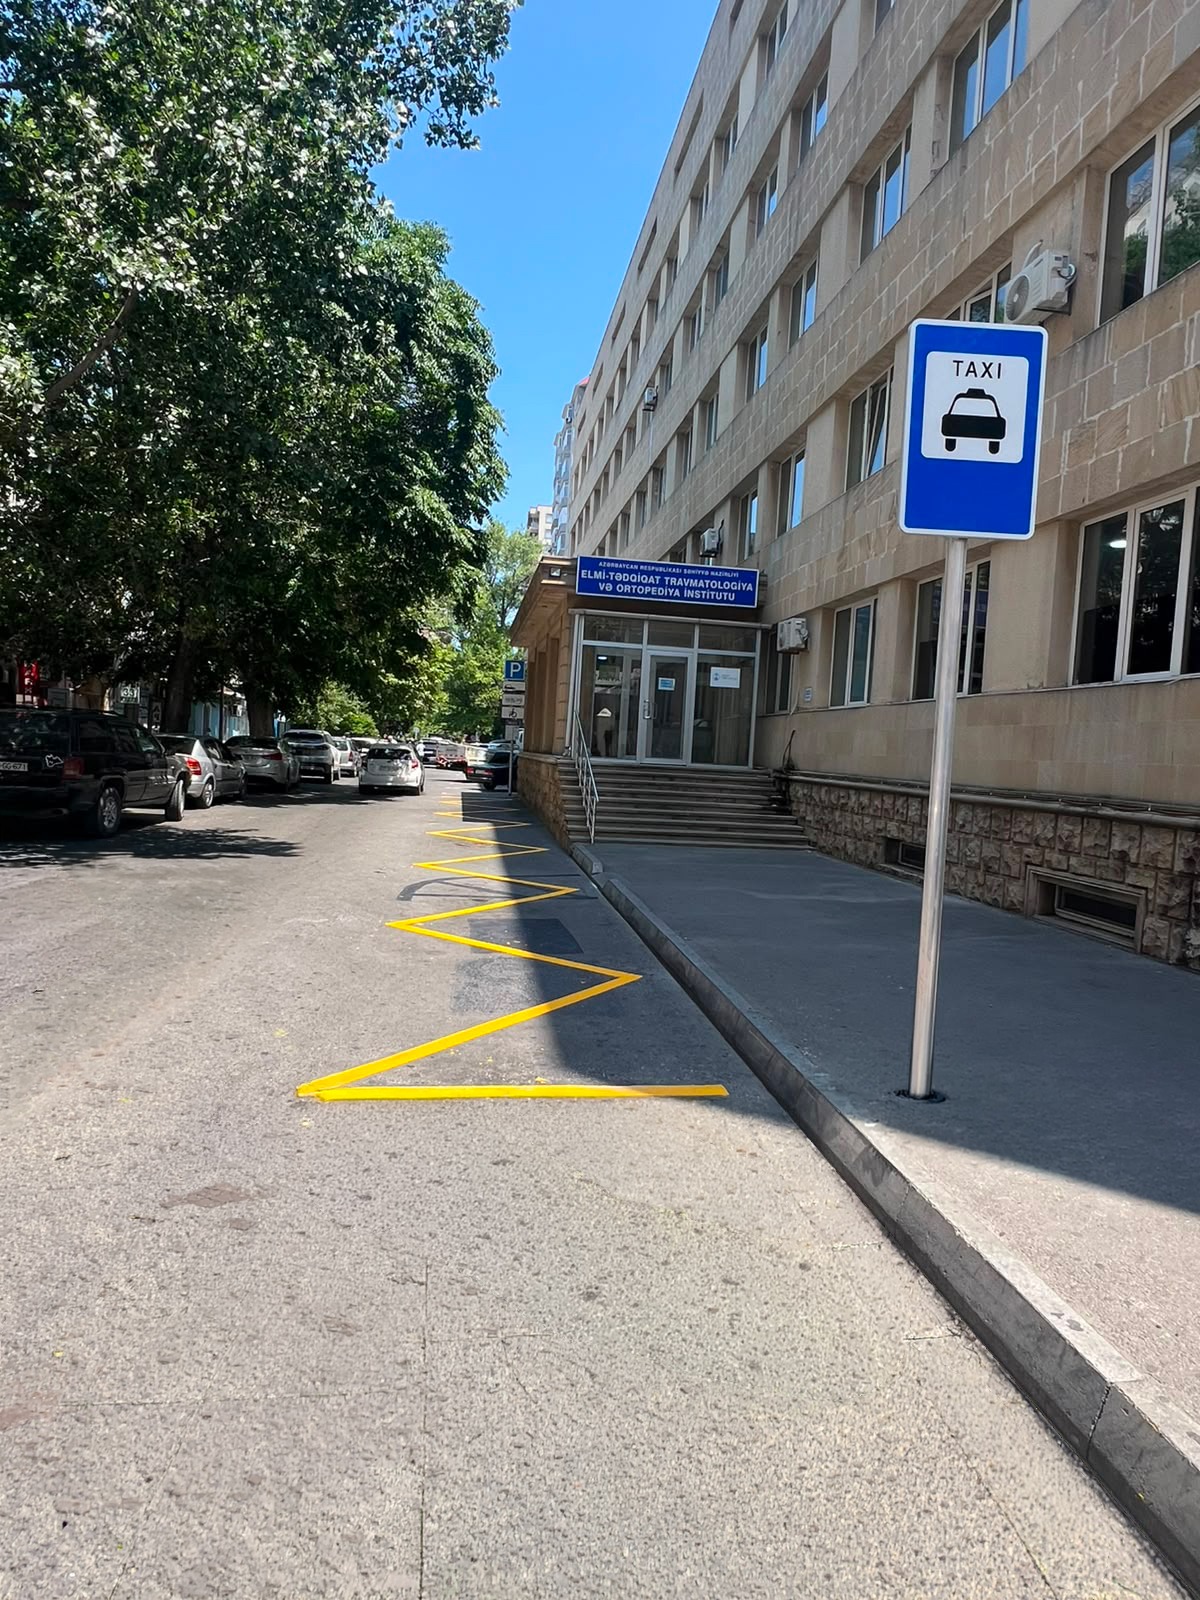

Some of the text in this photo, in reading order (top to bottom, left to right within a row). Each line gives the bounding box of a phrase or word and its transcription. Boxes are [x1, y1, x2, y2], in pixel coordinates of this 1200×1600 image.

[953, 360, 1002, 379] TAXI
[598, 561, 638, 570] AZƏRBAYCAN
[581, 569, 753, 592] ELMİ-TƏDQİQAT TRAVMATOLOGİYA
[598, 582, 736, 601] VƏ ORTOPEDİYA İNSTİTUTU
[510, 662, 521, 677] P
